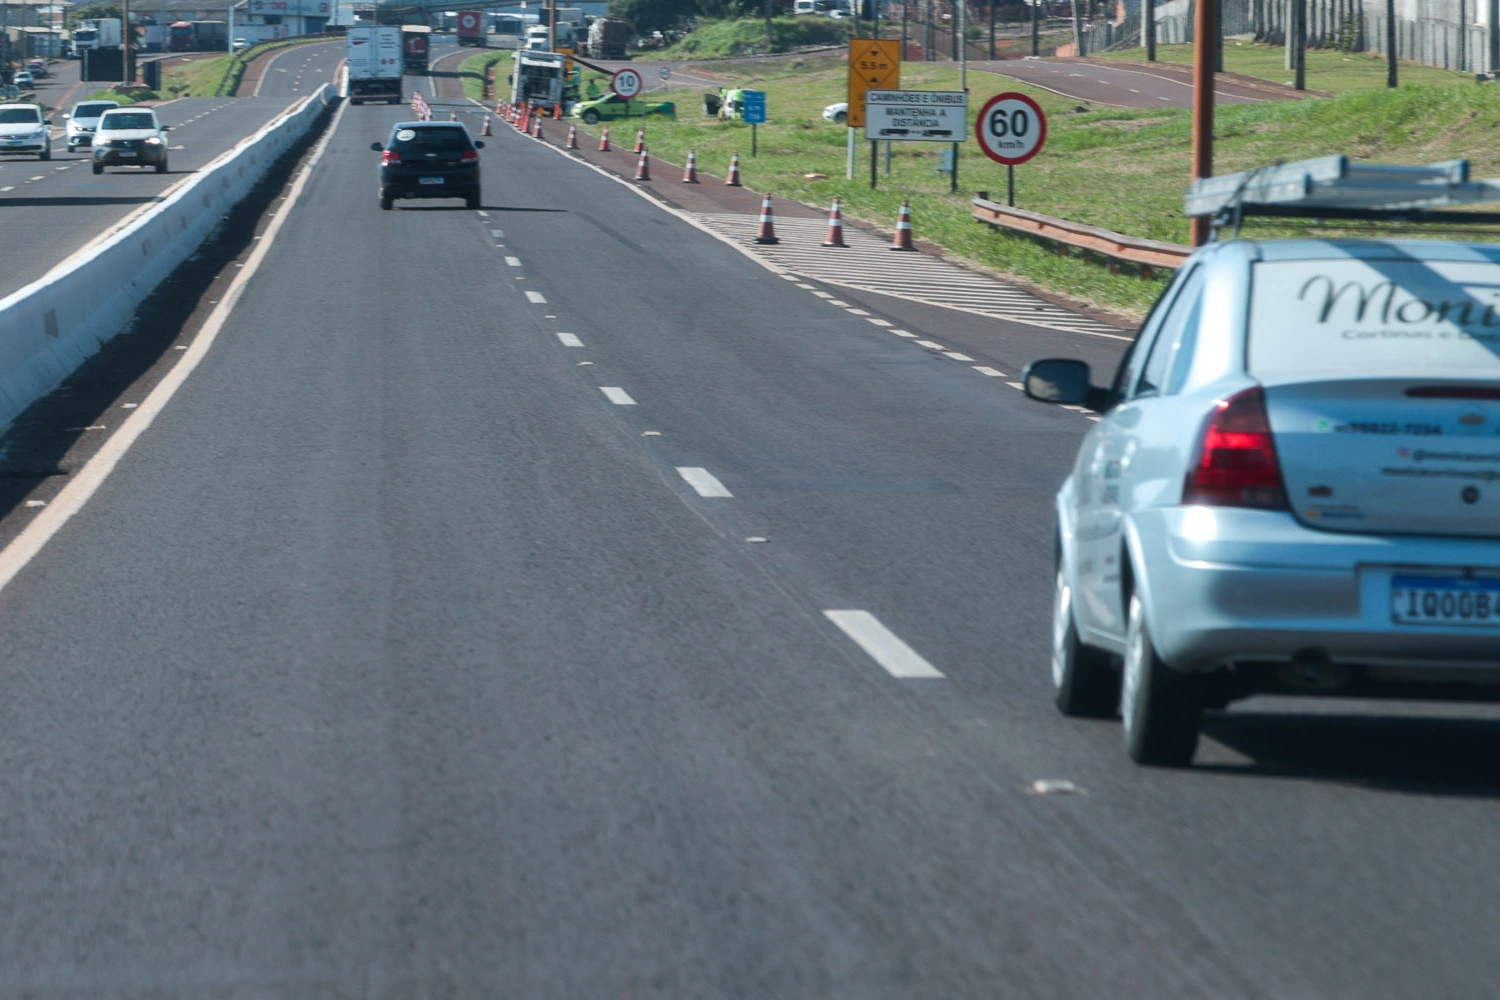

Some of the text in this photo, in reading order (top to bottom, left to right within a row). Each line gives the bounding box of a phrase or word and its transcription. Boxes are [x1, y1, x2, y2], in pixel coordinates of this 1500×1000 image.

[923, 94, 929, 103] E
[885, 107, 948, 117] MANTENHA A
[990, 109, 1029, 138] 60
